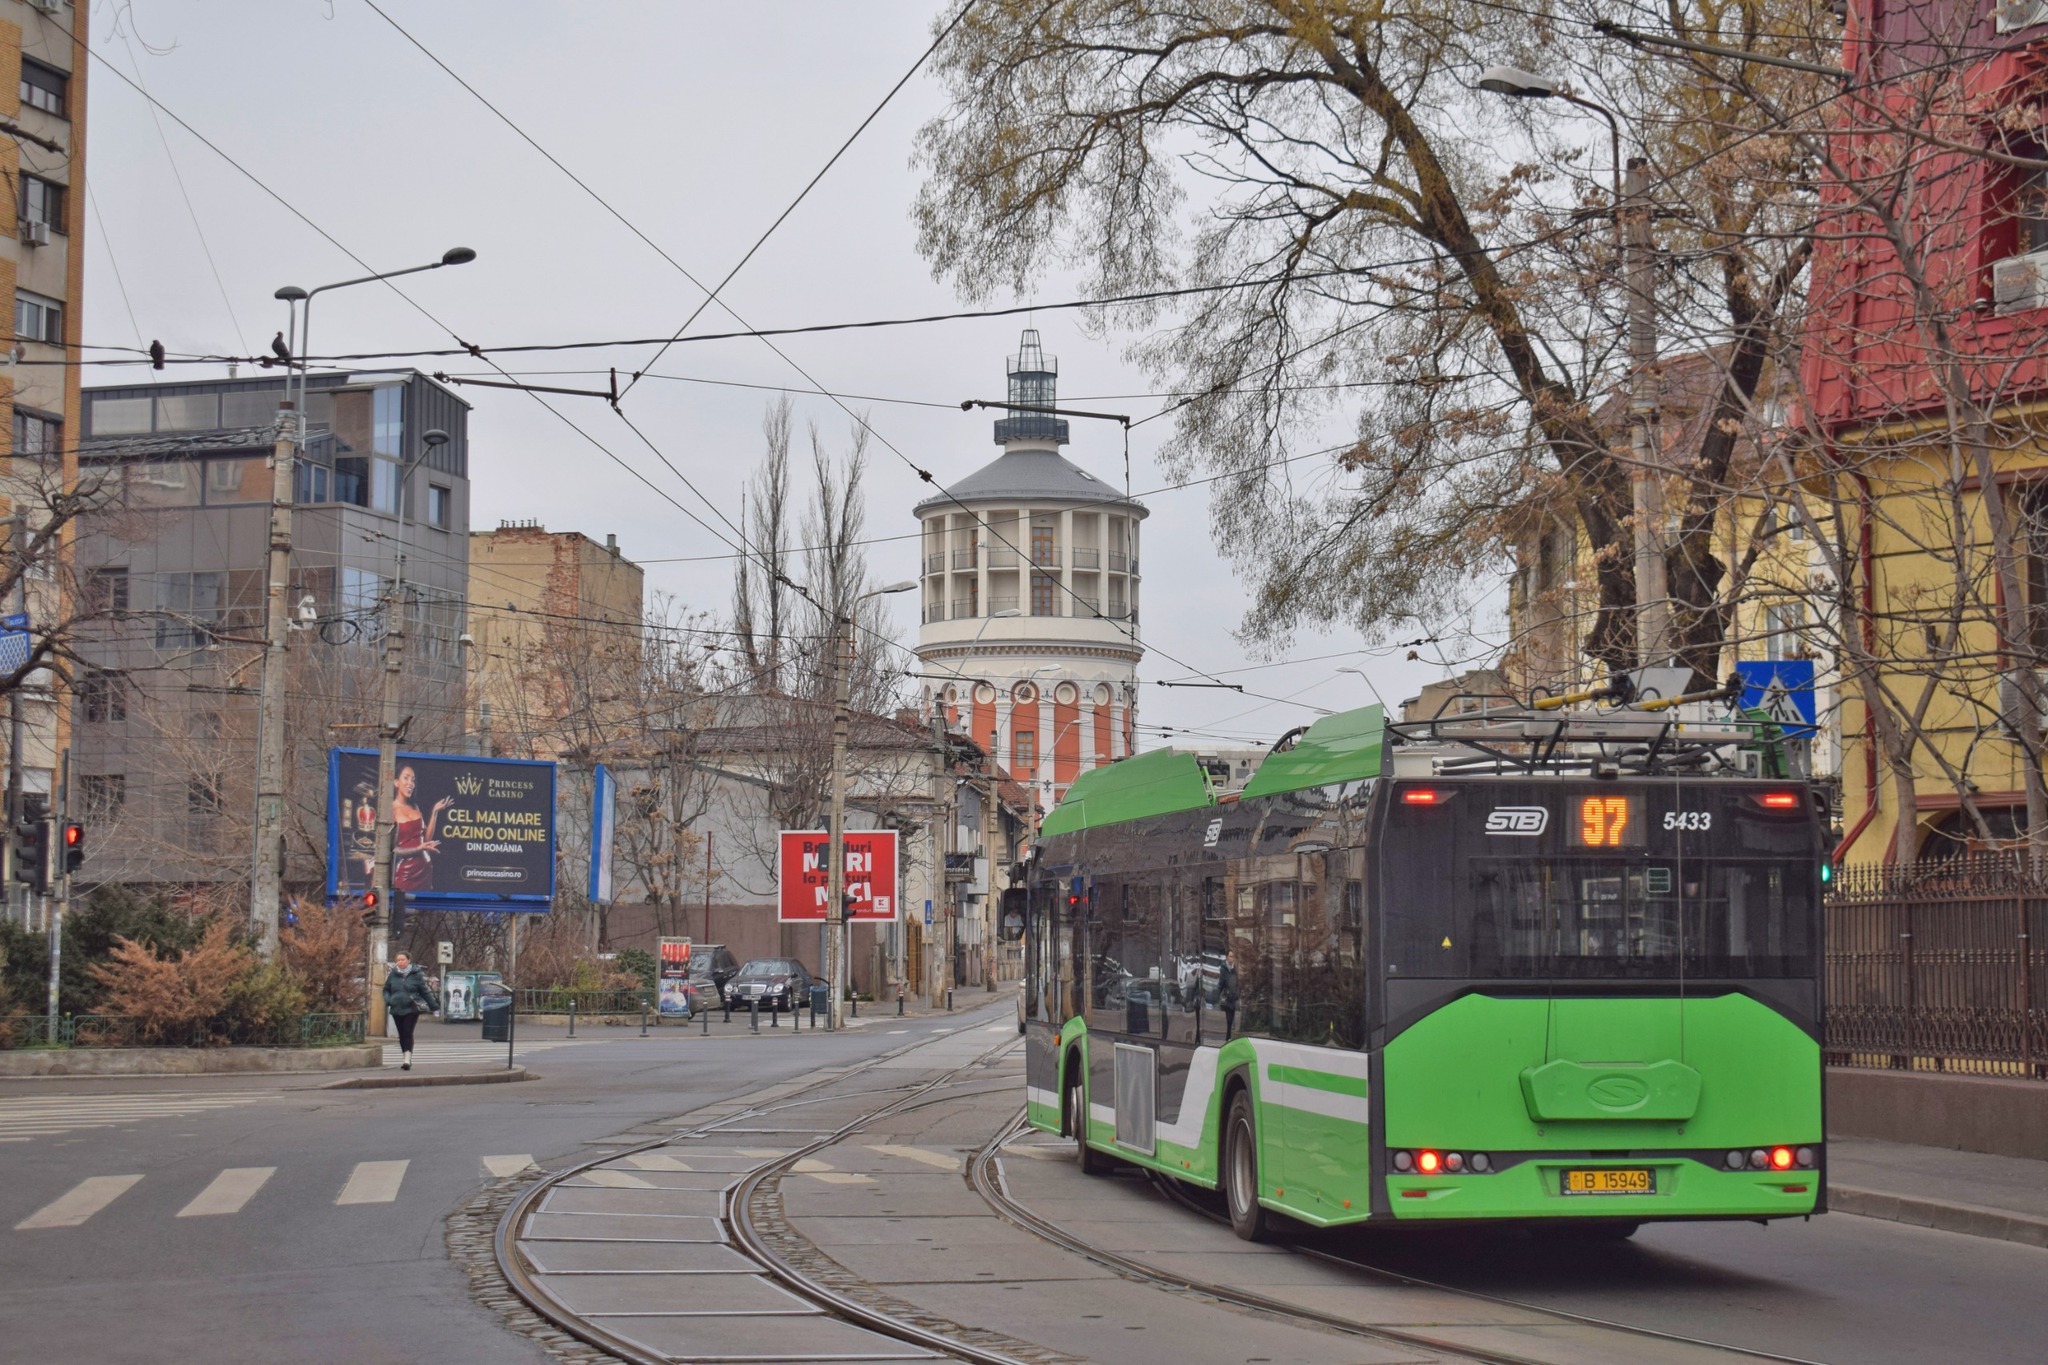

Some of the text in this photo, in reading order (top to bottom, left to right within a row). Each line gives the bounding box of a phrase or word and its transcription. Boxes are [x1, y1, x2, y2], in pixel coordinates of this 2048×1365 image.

[488, 778, 534, 790] PRINCESS
[488, 788, 524, 799] CASINO
[448, 808, 542, 826] CEL MAI MARE
[1485, 809, 1545, 832] STB
[1583, 798, 1626, 845] 97
[1663, 811, 1711, 831] 5433
[443, 825, 546, 842] CAZINO ONLINE
[466, 842, 482, 852] DIN
[803, 852, 872, 873] MRI
[466, 868, 522, 878] princesscasino.ro
[814, 882, 872, 906] MCI
[1584, 1172, 1647, 1189] B 15949
